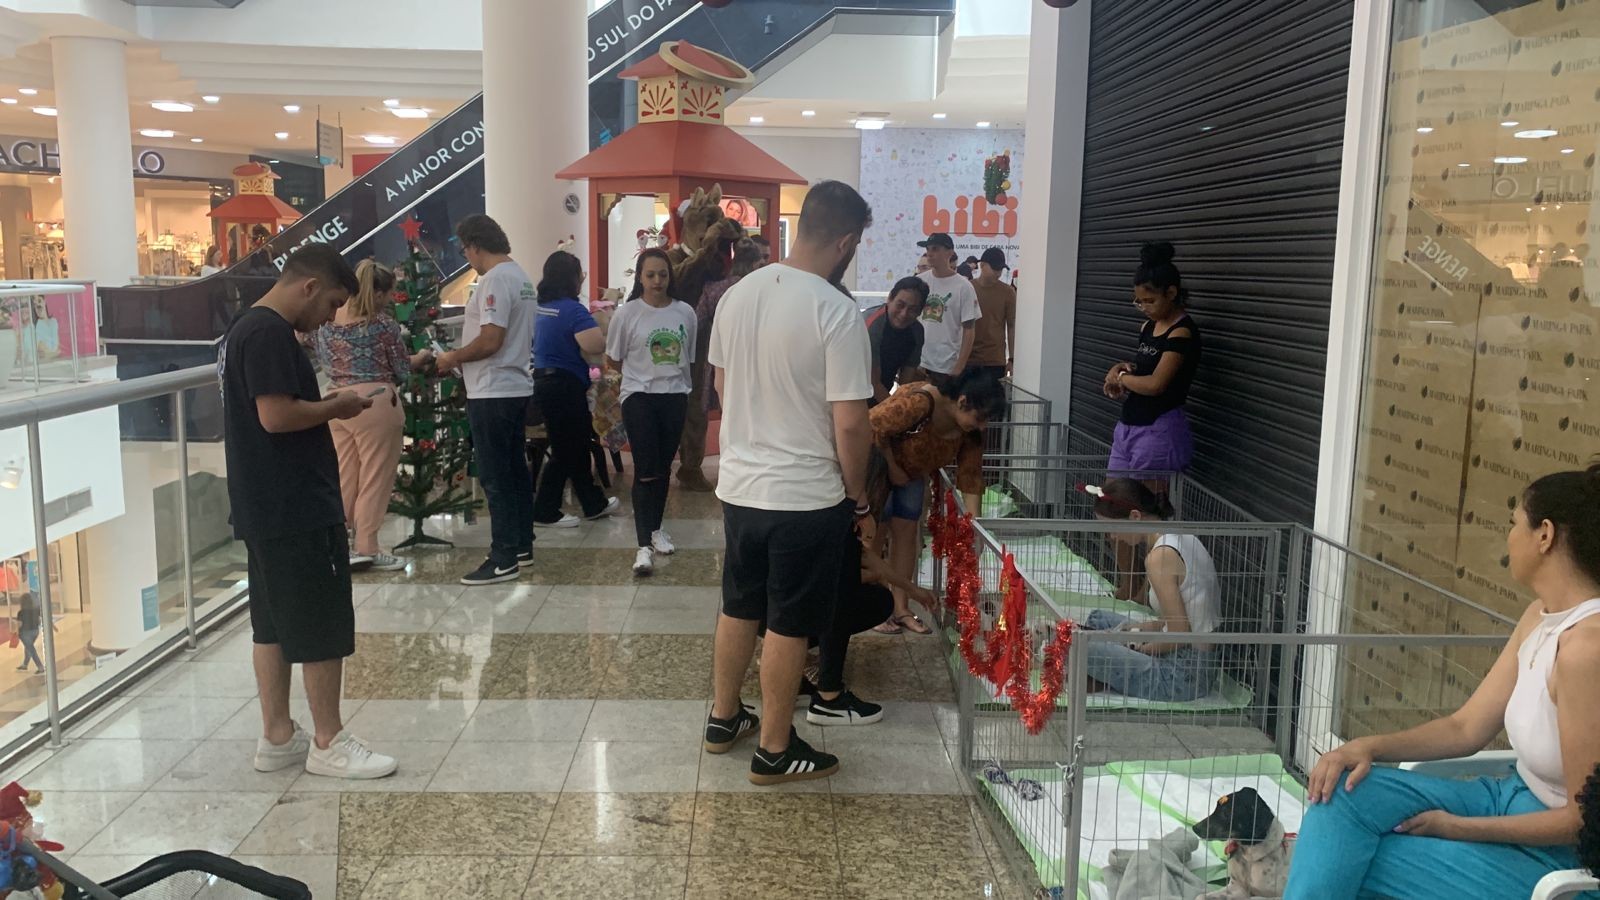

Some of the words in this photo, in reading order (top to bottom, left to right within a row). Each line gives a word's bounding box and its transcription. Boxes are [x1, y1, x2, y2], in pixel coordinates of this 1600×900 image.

[596, 25, 629, 52] SUL
[627, 5, 655, 30] DO
[385, 186, 399, 202] A
[396, 148, 452, 192] MAIOR
[922, 194, 1019, 238] bibi
